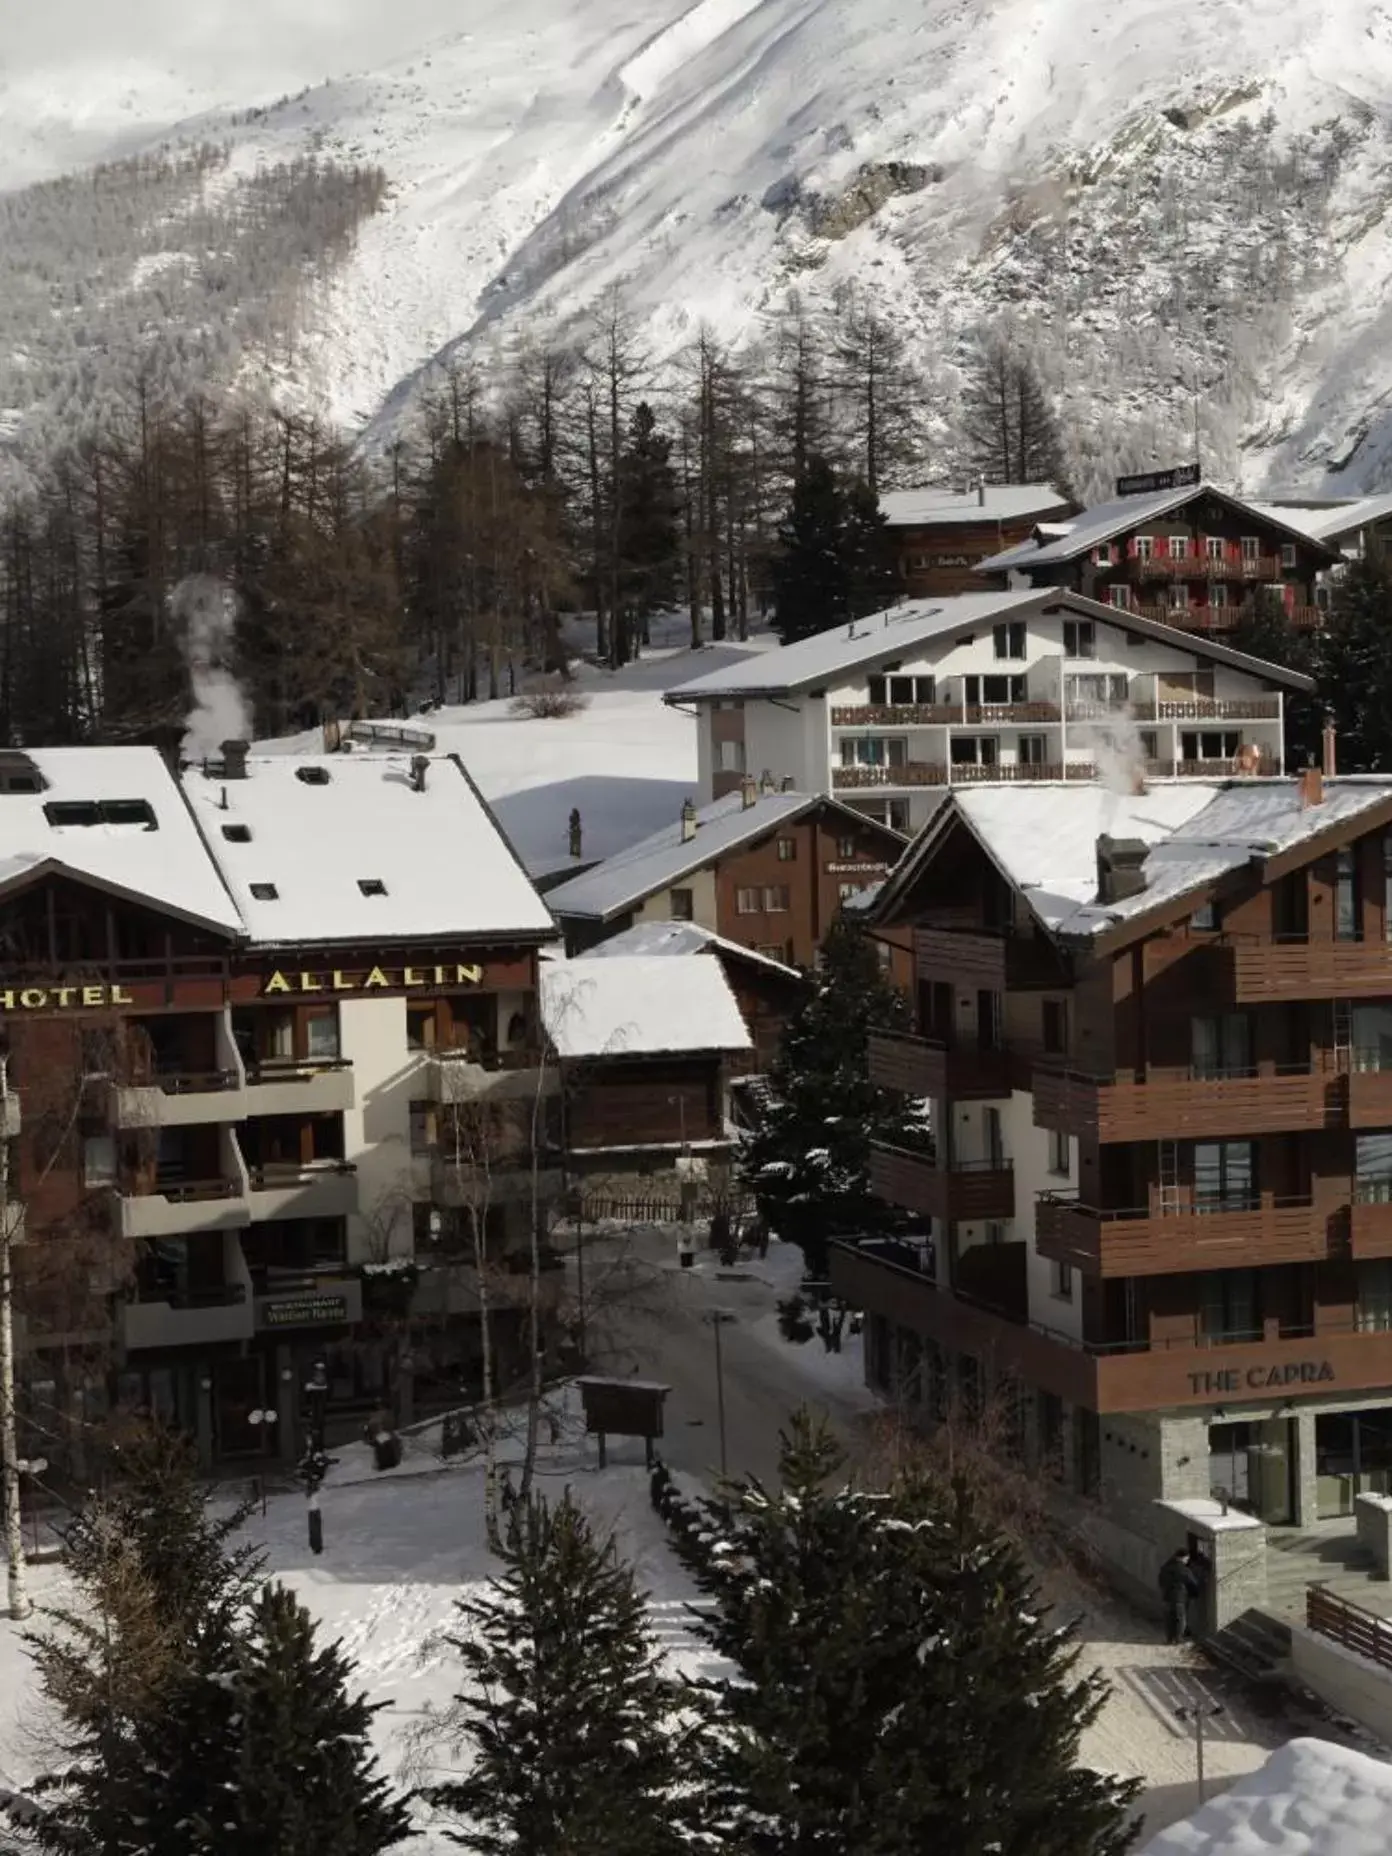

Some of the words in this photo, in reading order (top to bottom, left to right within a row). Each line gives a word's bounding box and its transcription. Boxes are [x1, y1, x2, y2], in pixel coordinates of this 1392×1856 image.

[264, 964, 483, 993] ALLALIN
[0, 985, 133, 1009] HOTEL
[1187, 1369, 1241, 1395] THE
[1246, 1360, 1336, 1389] CAPRA
